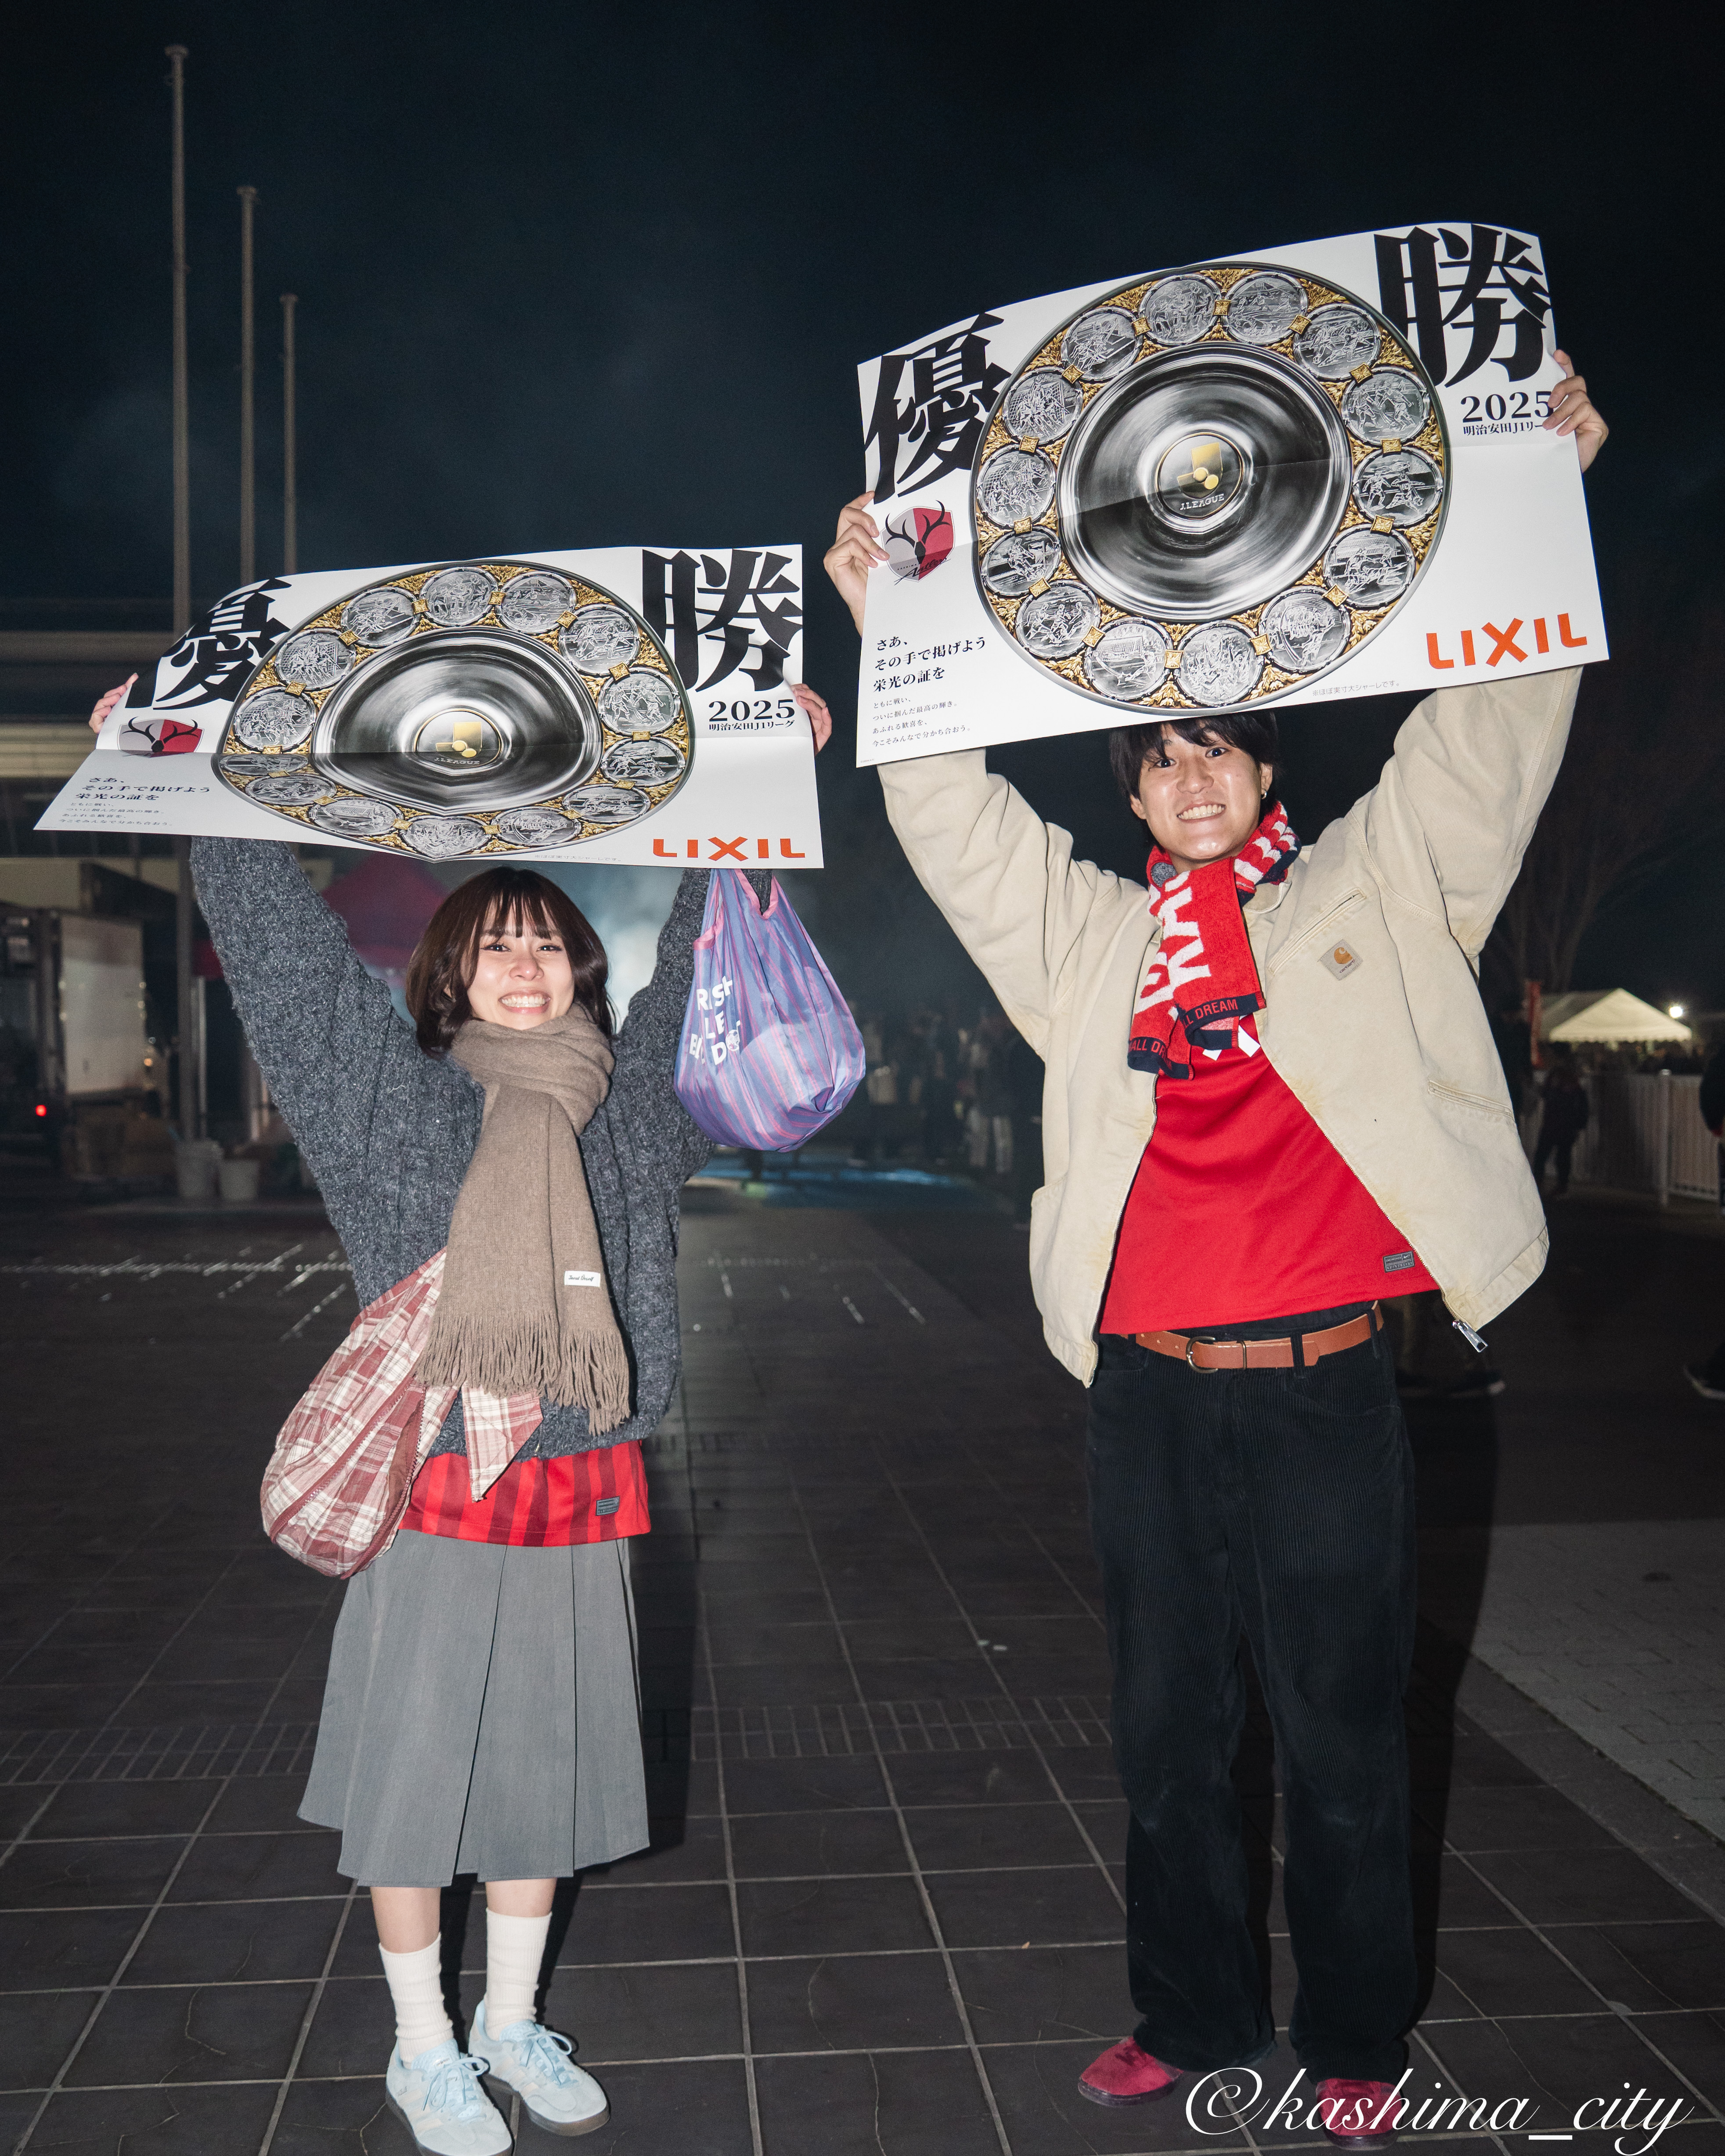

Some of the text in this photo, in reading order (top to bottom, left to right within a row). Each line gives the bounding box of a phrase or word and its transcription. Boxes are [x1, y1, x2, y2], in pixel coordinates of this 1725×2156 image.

[864, 223, 1551, 504] 優 勝
[1461, 391, 1554, 423] 2025
[1463, 422, 1549, 436] 明治安田J1リー
[1180, 494, 1224, 510] J.LEAGUE
[642, 549, 803, 692] 勝
[877, 636, 908, 651] さあ、
[1426, 613, 1587, 668] LIXIL
[875, 637, 985, 671] その手で掲げよう
[873, 667, 945, 692] 栄光の証を
[709, 699, 795, 722] 2025
[873, 698, 911, 709] ともに戦い、
[709, 720, 795, 731] 明治安田J1リーグ
[872, 725, 970, 747] 今こそみんなで分かち合おう。
[873, 719, 927, 734] あふれる歓喜を、
[653, 836, 805, 861] LIXIL
[1195, 999, 1238, 1020] DREAM
